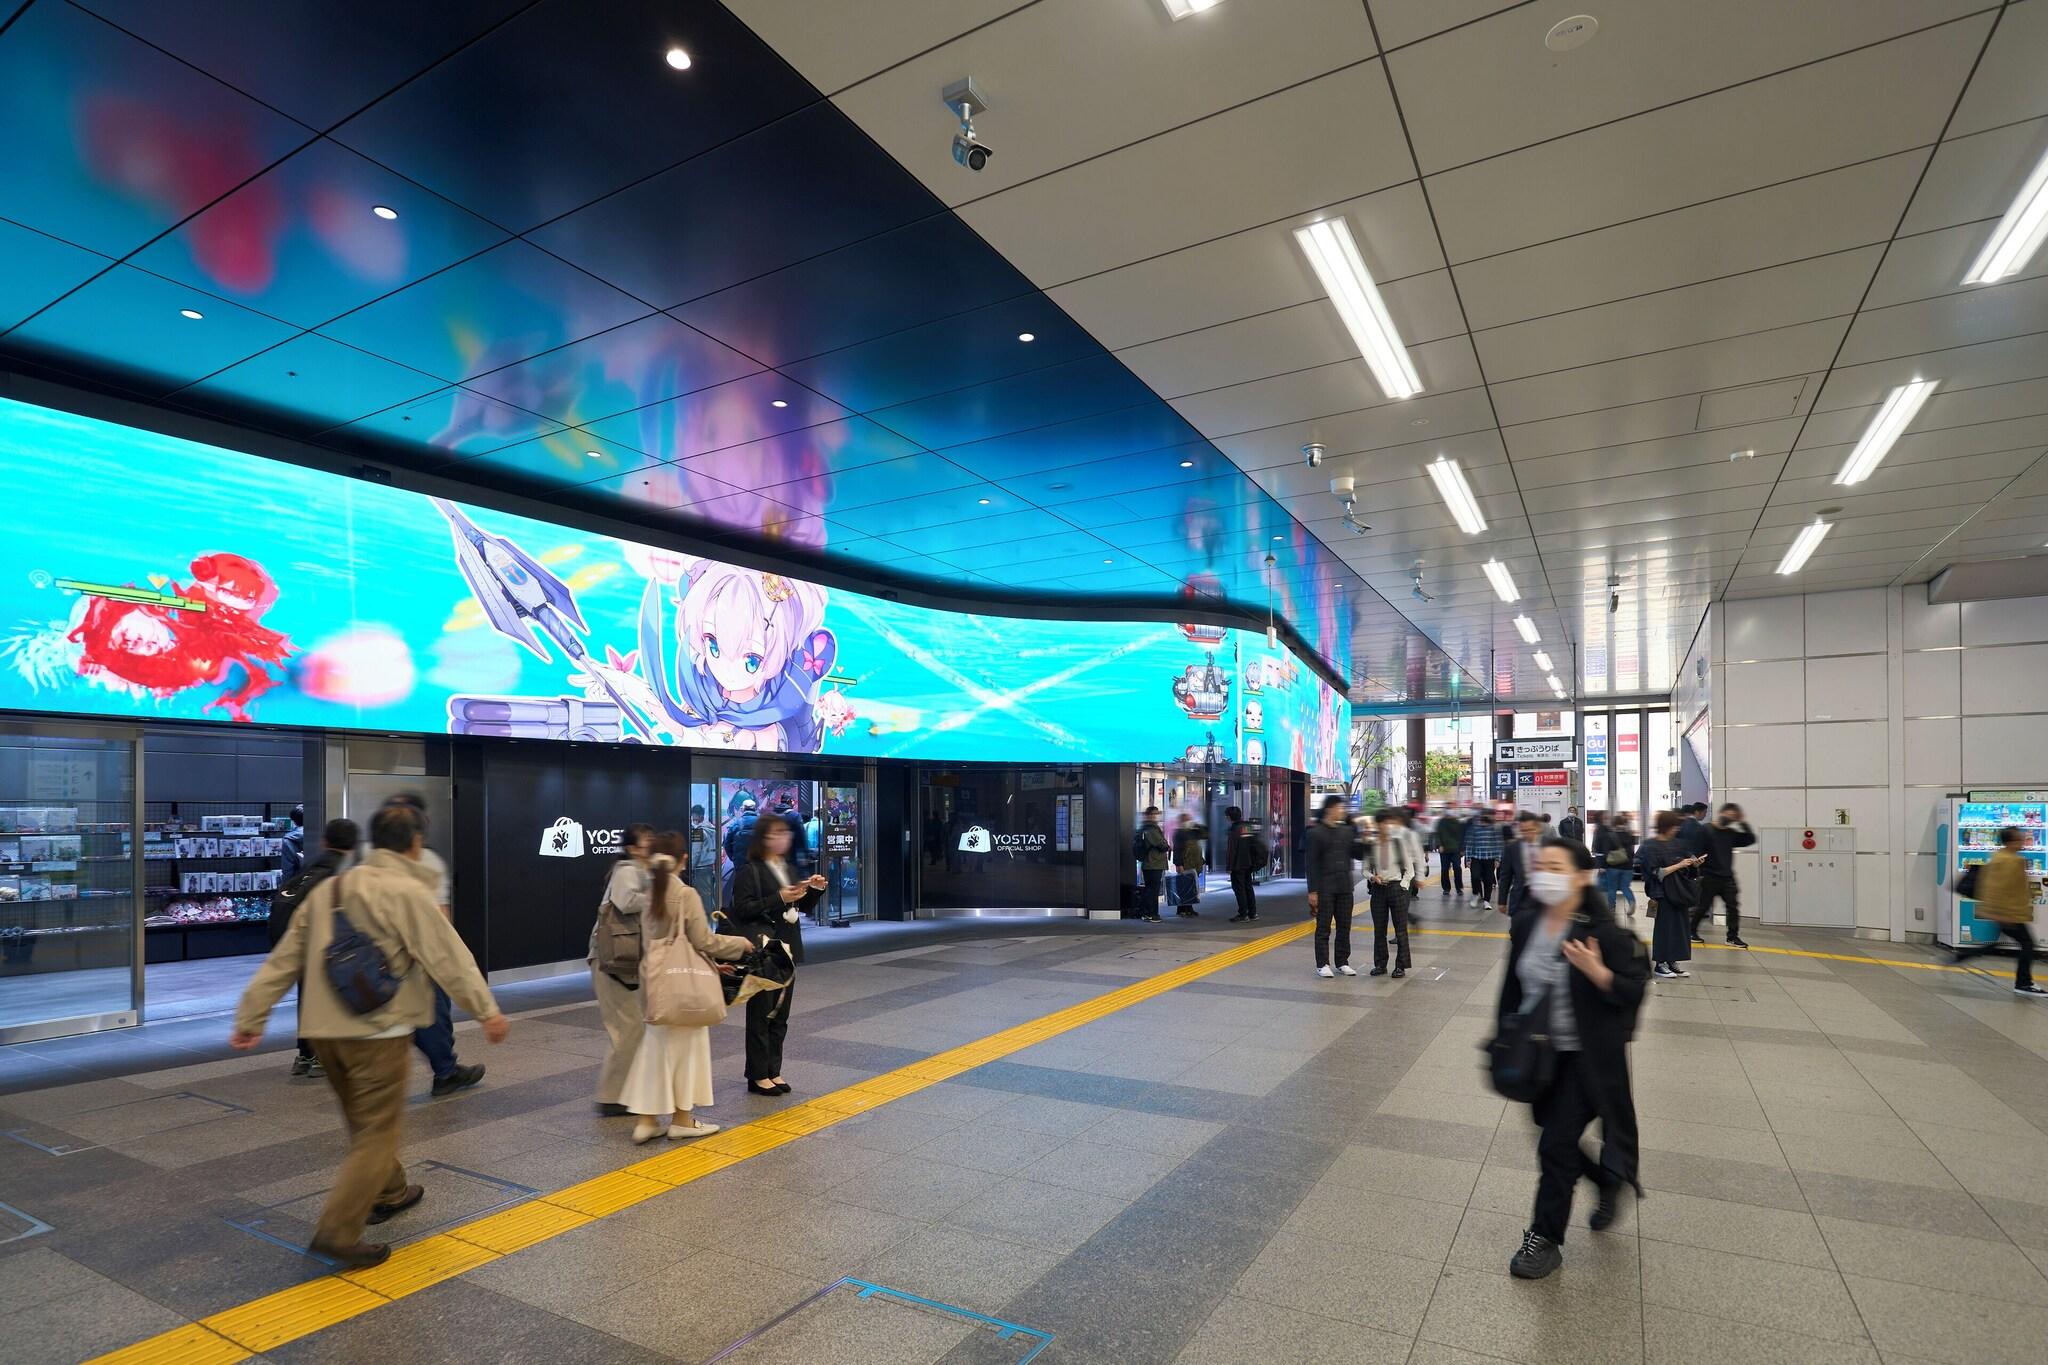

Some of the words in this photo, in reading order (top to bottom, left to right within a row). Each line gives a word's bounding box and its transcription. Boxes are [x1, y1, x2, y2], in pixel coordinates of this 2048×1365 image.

[1516, 744, 1560, 753] きっぷうりば
[586, 829, 625, 846] YOS
[827, 834, 854, 845] 営業中
[992, 834, 1047, 845] YOSTAR
